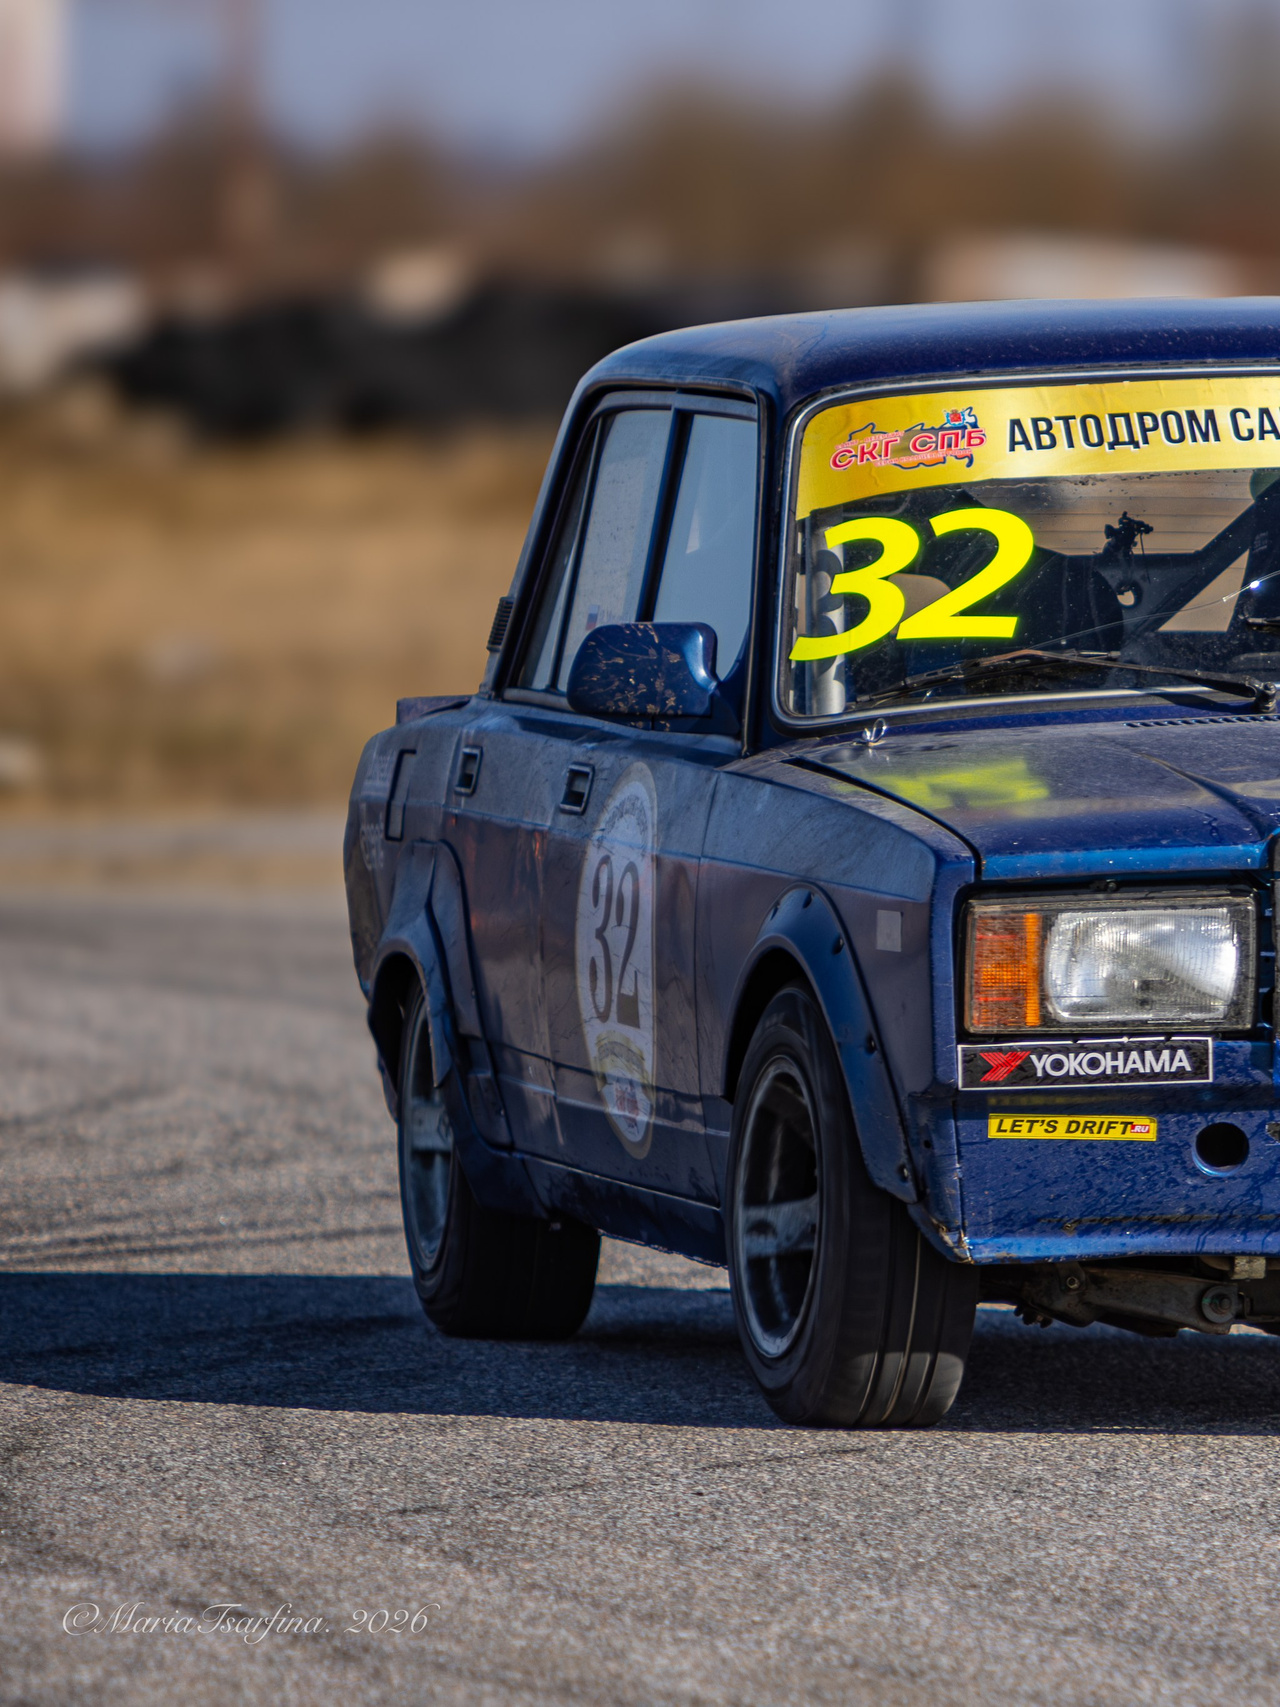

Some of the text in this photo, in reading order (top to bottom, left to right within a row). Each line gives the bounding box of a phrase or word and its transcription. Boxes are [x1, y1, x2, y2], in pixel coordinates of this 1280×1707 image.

[830, 434, 900, 470] СКГ
[909, 428, 987, 454] СПБ
[1008, 408, 1221, 452] АВТОДРОМ
[788, 507, 1035, 661] 32
[590, 855, 641, 1030] 32
[1029, 1049, 1192, 1077] YOKOHAMA
[996, 1118, 1059, 1134] LET'S
